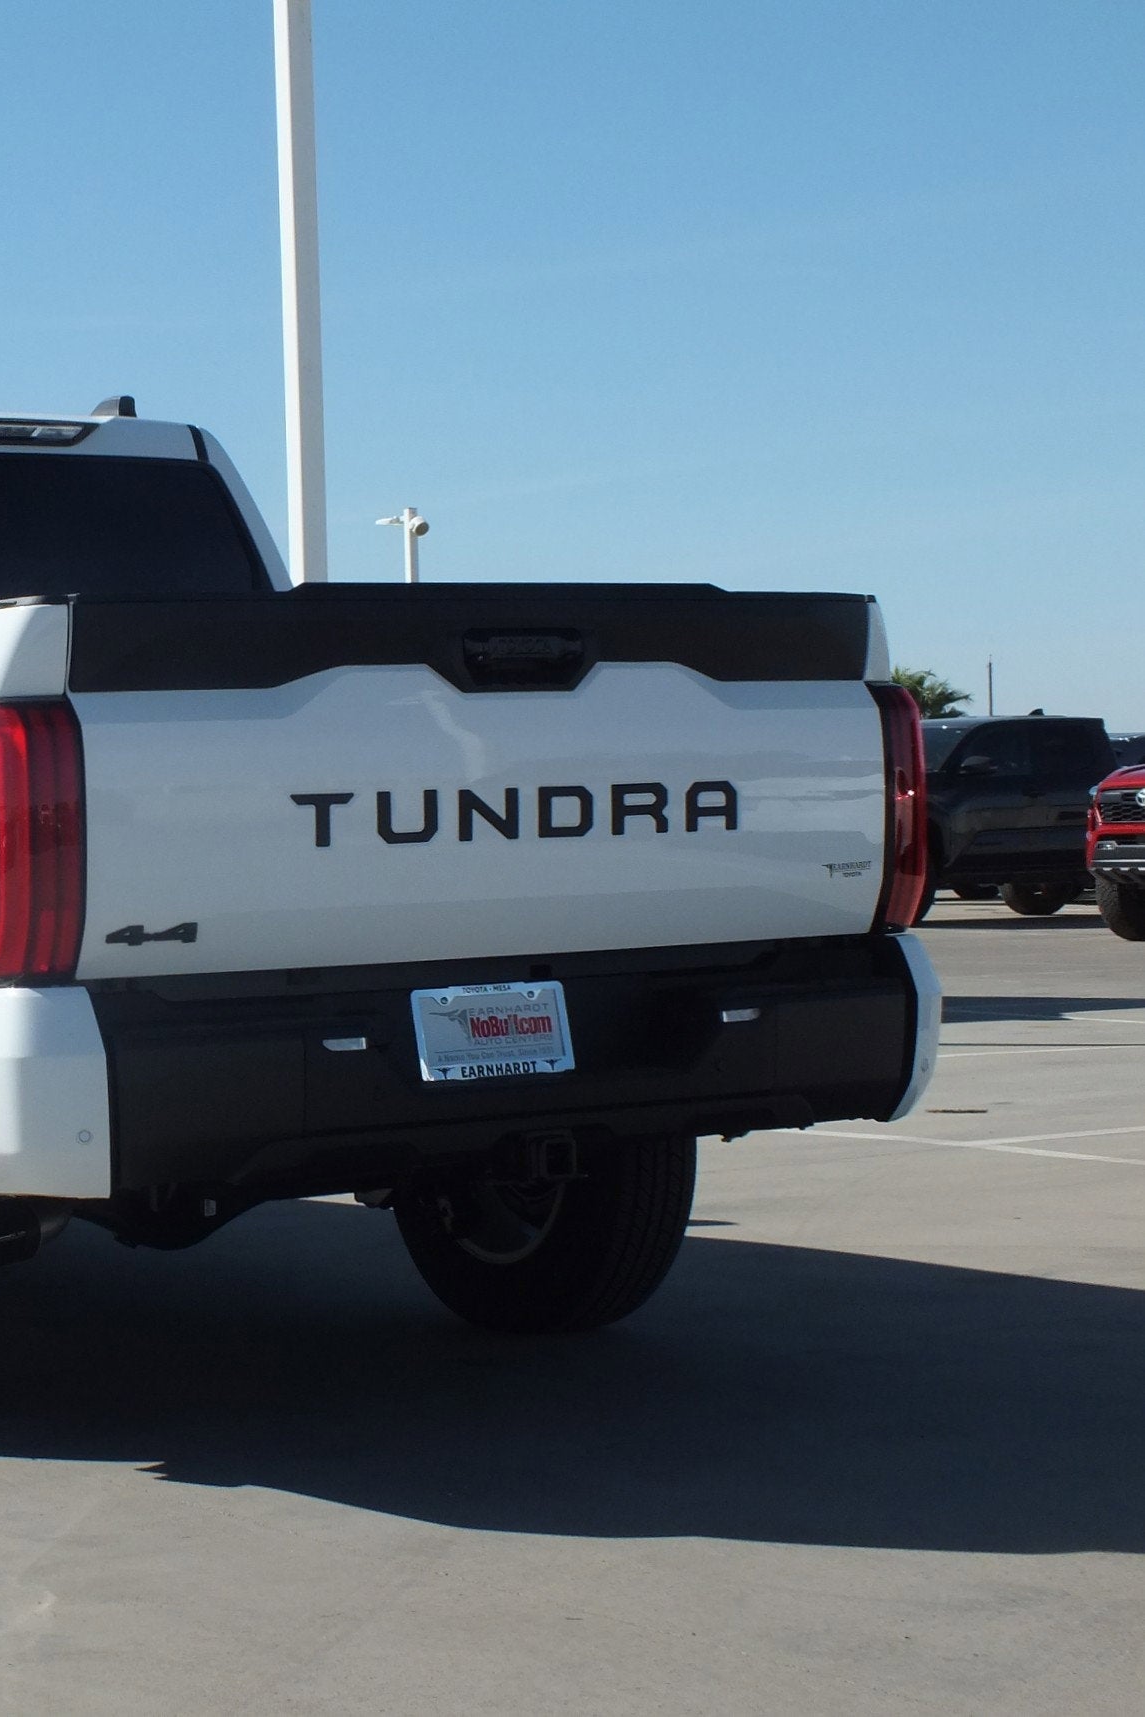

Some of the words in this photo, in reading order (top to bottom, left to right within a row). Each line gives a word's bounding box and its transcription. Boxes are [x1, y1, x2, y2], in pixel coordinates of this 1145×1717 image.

[289, 780, 738, 848] TUNDRA
[462, 986, 488, 994] TOYOTA
[493, 984, 512, 992] MESA
[468, 1003, 549, 1017] EARNHARDT
[474, 1037, 503, 1046] AUTO
[505, 1034, 553, 1044] CENTERS
[461, 1061, 538, 1078] EARNHARDT
